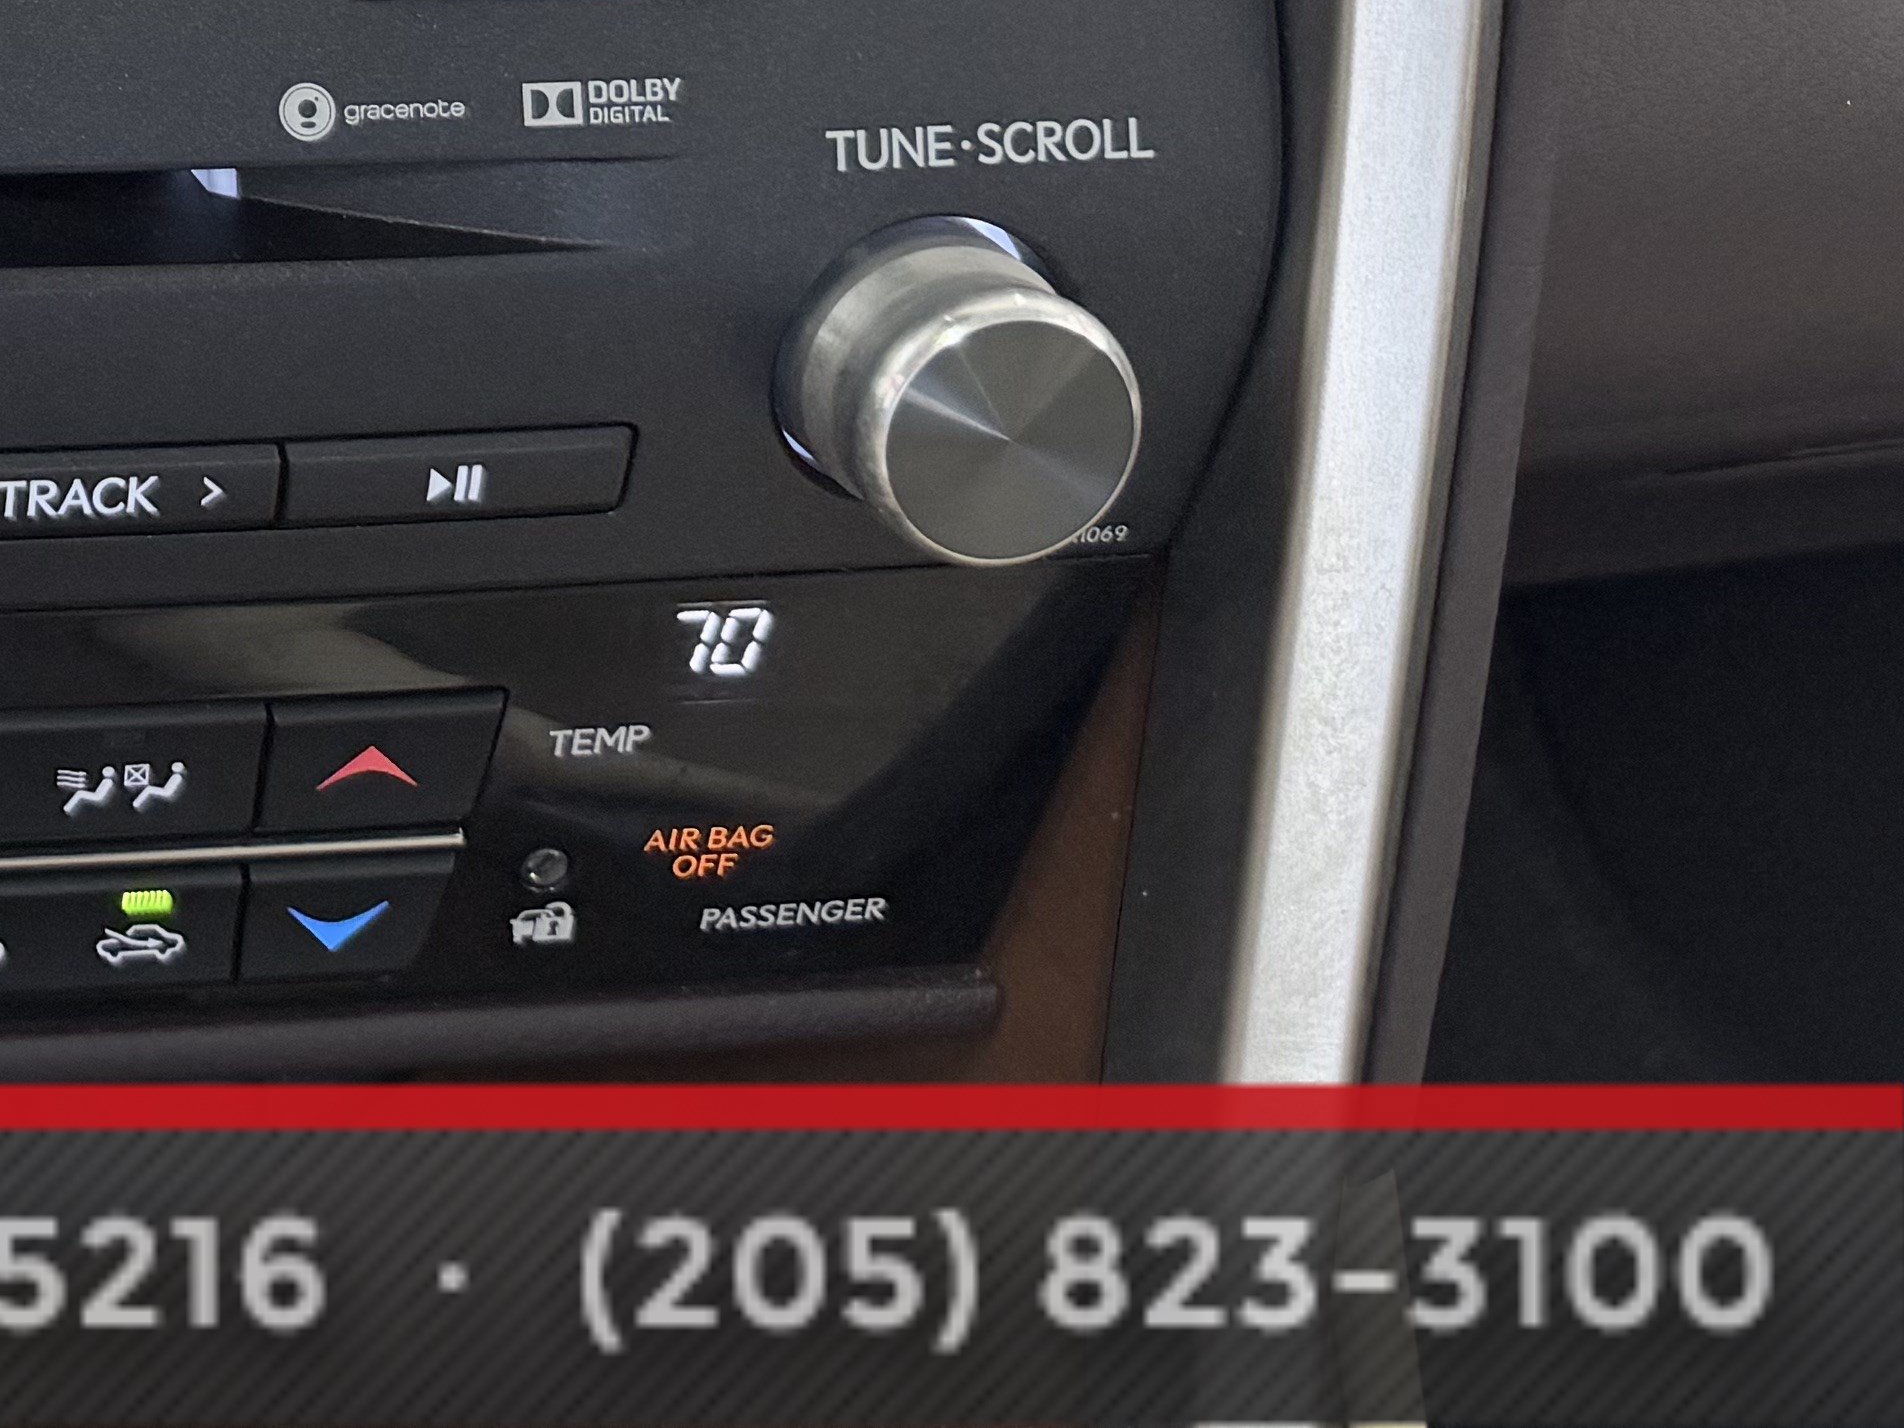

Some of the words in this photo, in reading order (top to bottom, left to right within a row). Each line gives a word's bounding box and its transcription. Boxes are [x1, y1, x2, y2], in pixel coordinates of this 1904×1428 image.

[587, 77, 682, 104] DOLBY
[343, 98, 467, 126] gracenote
[588, 104, 671, 125] DIGITAL
[676, 606, 774, 678] 70
[548, 723, 652, 757] TEMP
[643, 826, 701, 854] AIR
[706, 823, 776, 851] BAG
[671, 852, 740, 880] OFF
[698, 896, 888, 932] PASSENGER
